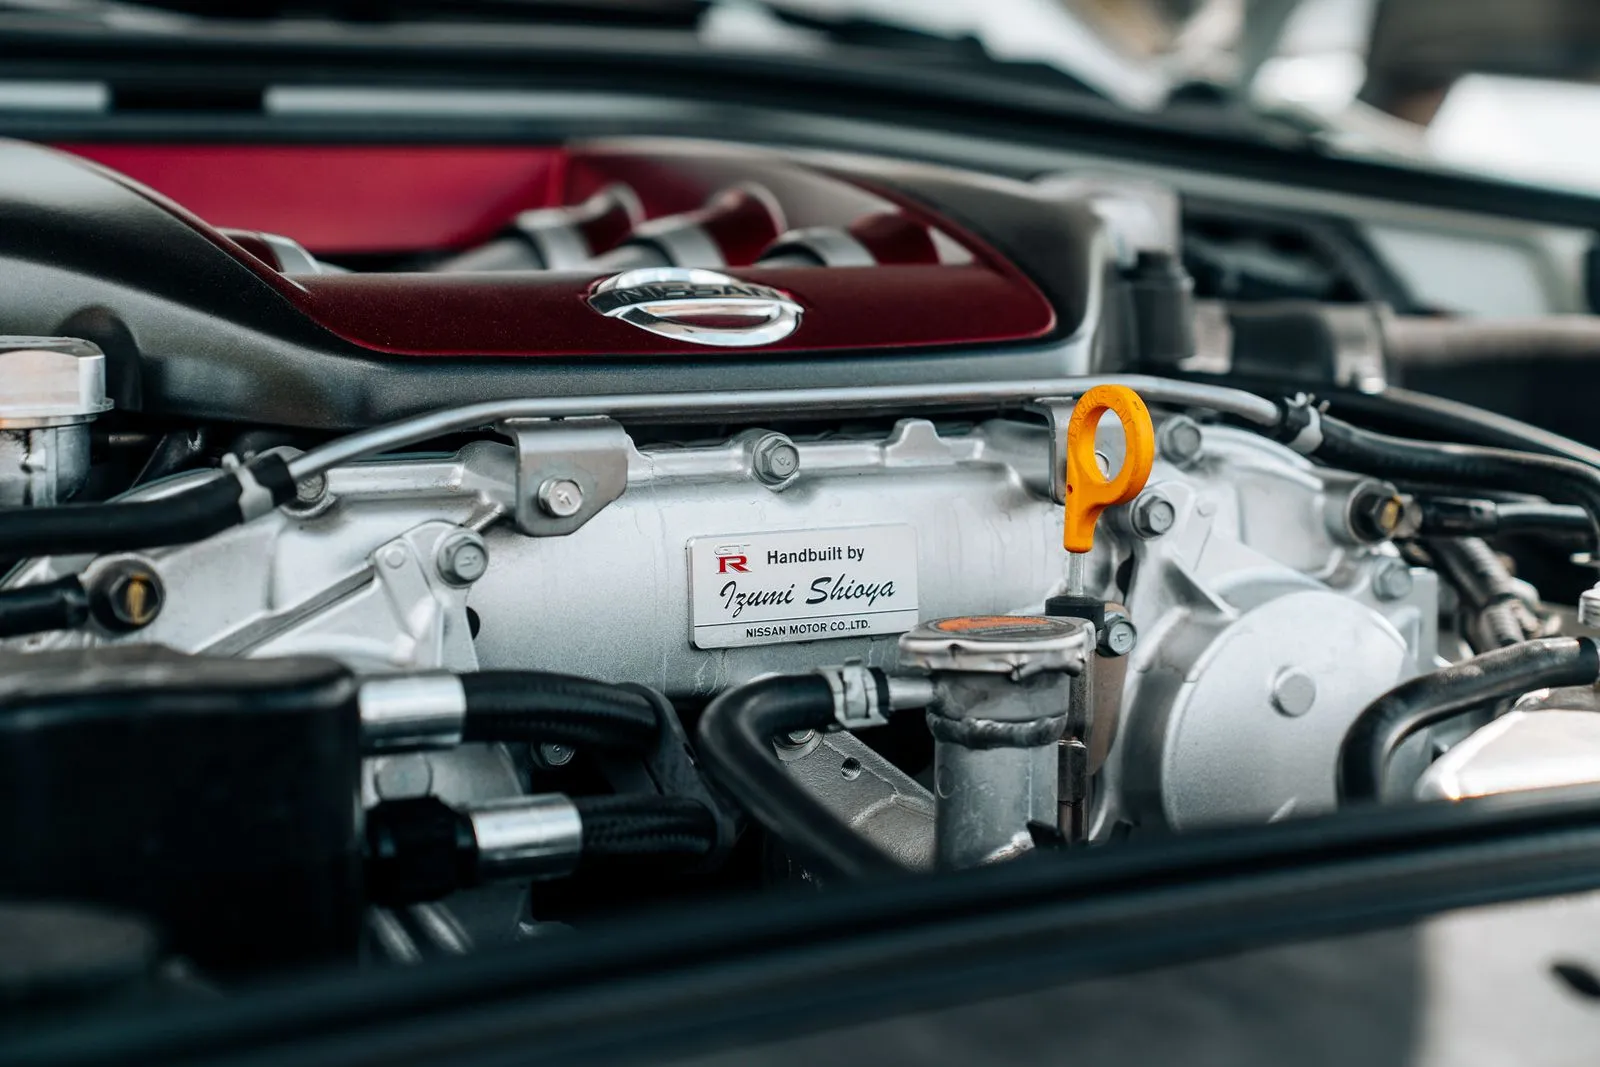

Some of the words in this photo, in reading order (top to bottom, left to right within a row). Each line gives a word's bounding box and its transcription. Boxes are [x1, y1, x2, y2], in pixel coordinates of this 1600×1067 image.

[714, 544, 752, 556] GT
[767, 547, 842, 565] Handbuilt
[848, 546, 865, 562] by
[715, 555, 752, 575] R
[719, 581, 795, 618] Izumi
[805, 573, 896, 606] Shioya
[746, 626, 786, 638] NISSAN
[789, 623, 827, 635] MOTOR
